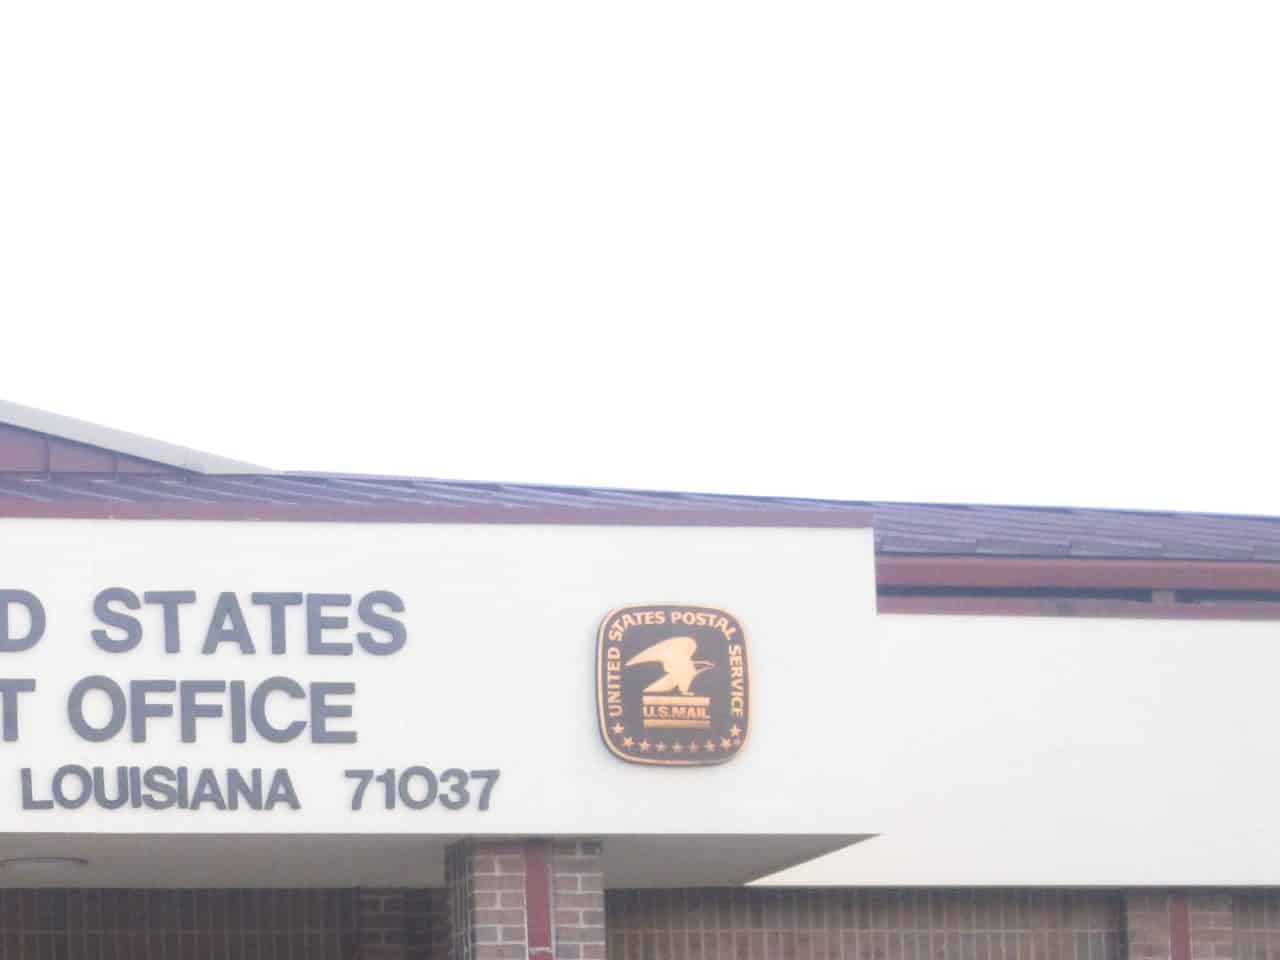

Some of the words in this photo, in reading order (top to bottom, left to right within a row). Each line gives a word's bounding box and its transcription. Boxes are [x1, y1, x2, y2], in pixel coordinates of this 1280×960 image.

[91, 588, 406, 656] STATES
[608, 612, 665, 641] STATES
[671, 612, 736, 640] POSTAL
[67, 675, 357, 744] OFFICE
[608, 647, 622, 717] UNITED
[729, 645, 744, 718] SERVICE
[21, 765, 301, 811] LOUISIANA
[345, 766, 500, 811] 71037
